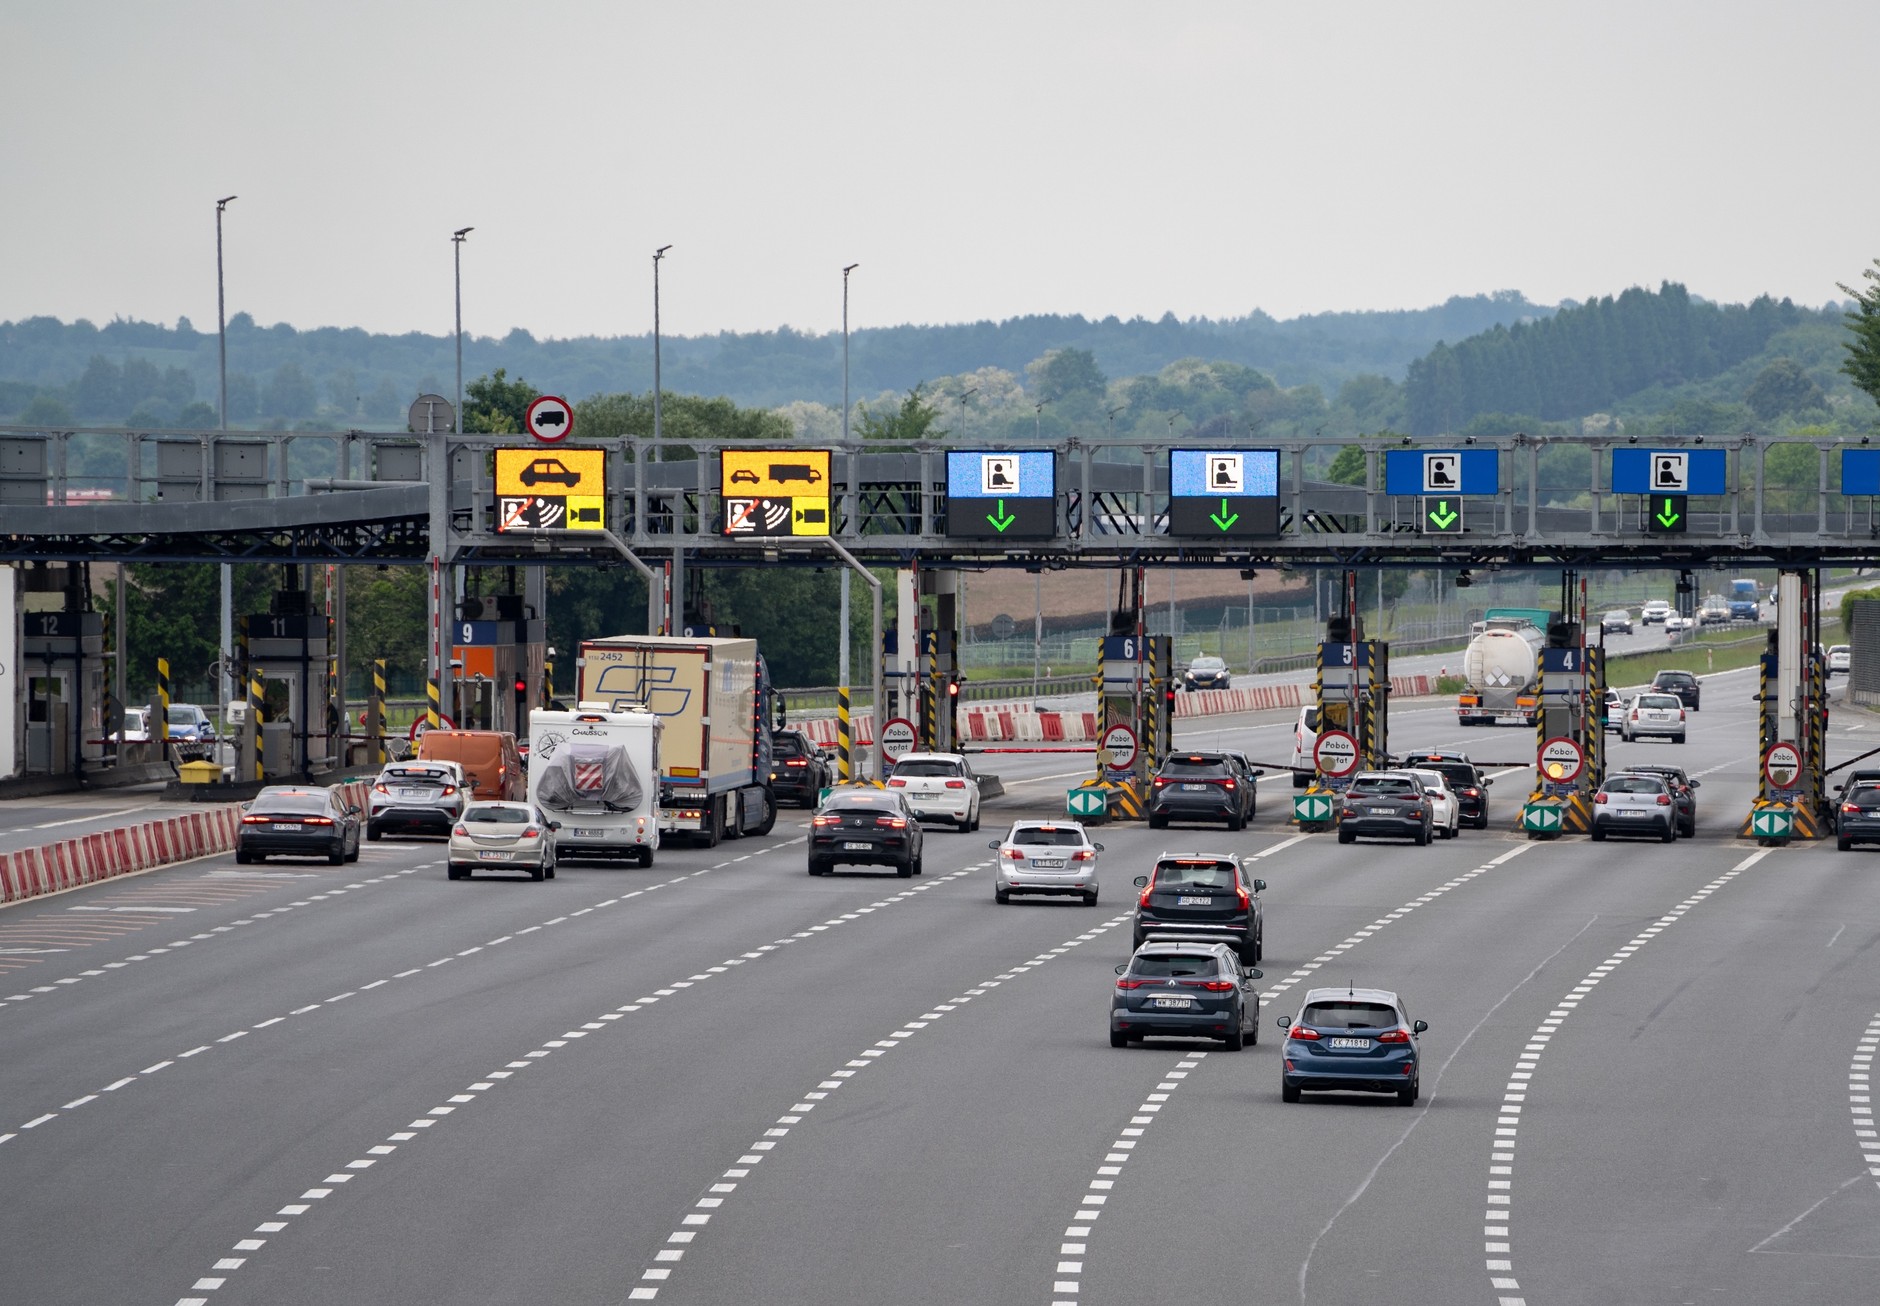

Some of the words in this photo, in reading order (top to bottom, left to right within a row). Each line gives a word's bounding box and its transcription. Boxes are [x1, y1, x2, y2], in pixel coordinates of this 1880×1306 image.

[41, 616, 58, 634] 12
[271, 618, 286, 636] 11
[463, 624, 472, 643] 9
[1124, 639, 1134, 658] 6
[1343, 645, 1352, 664] 5
[600, 653, 623, 661] 2452
[1563, 651, 1573, 670] 4
[1809, 657, 1816, 676] 3
[1110, 734, 1130, 742] Pobór
[889, 745, 908, 753] opłat
[1325, 741, 1349, 750] Pobór
[1550, 748, 1574, 756] Pobór
[1157, 999, 1167, 1007] WW
[1334, 1039, 1344, 1047] KK
[1345, 1039, 1369, 1047] 71818
